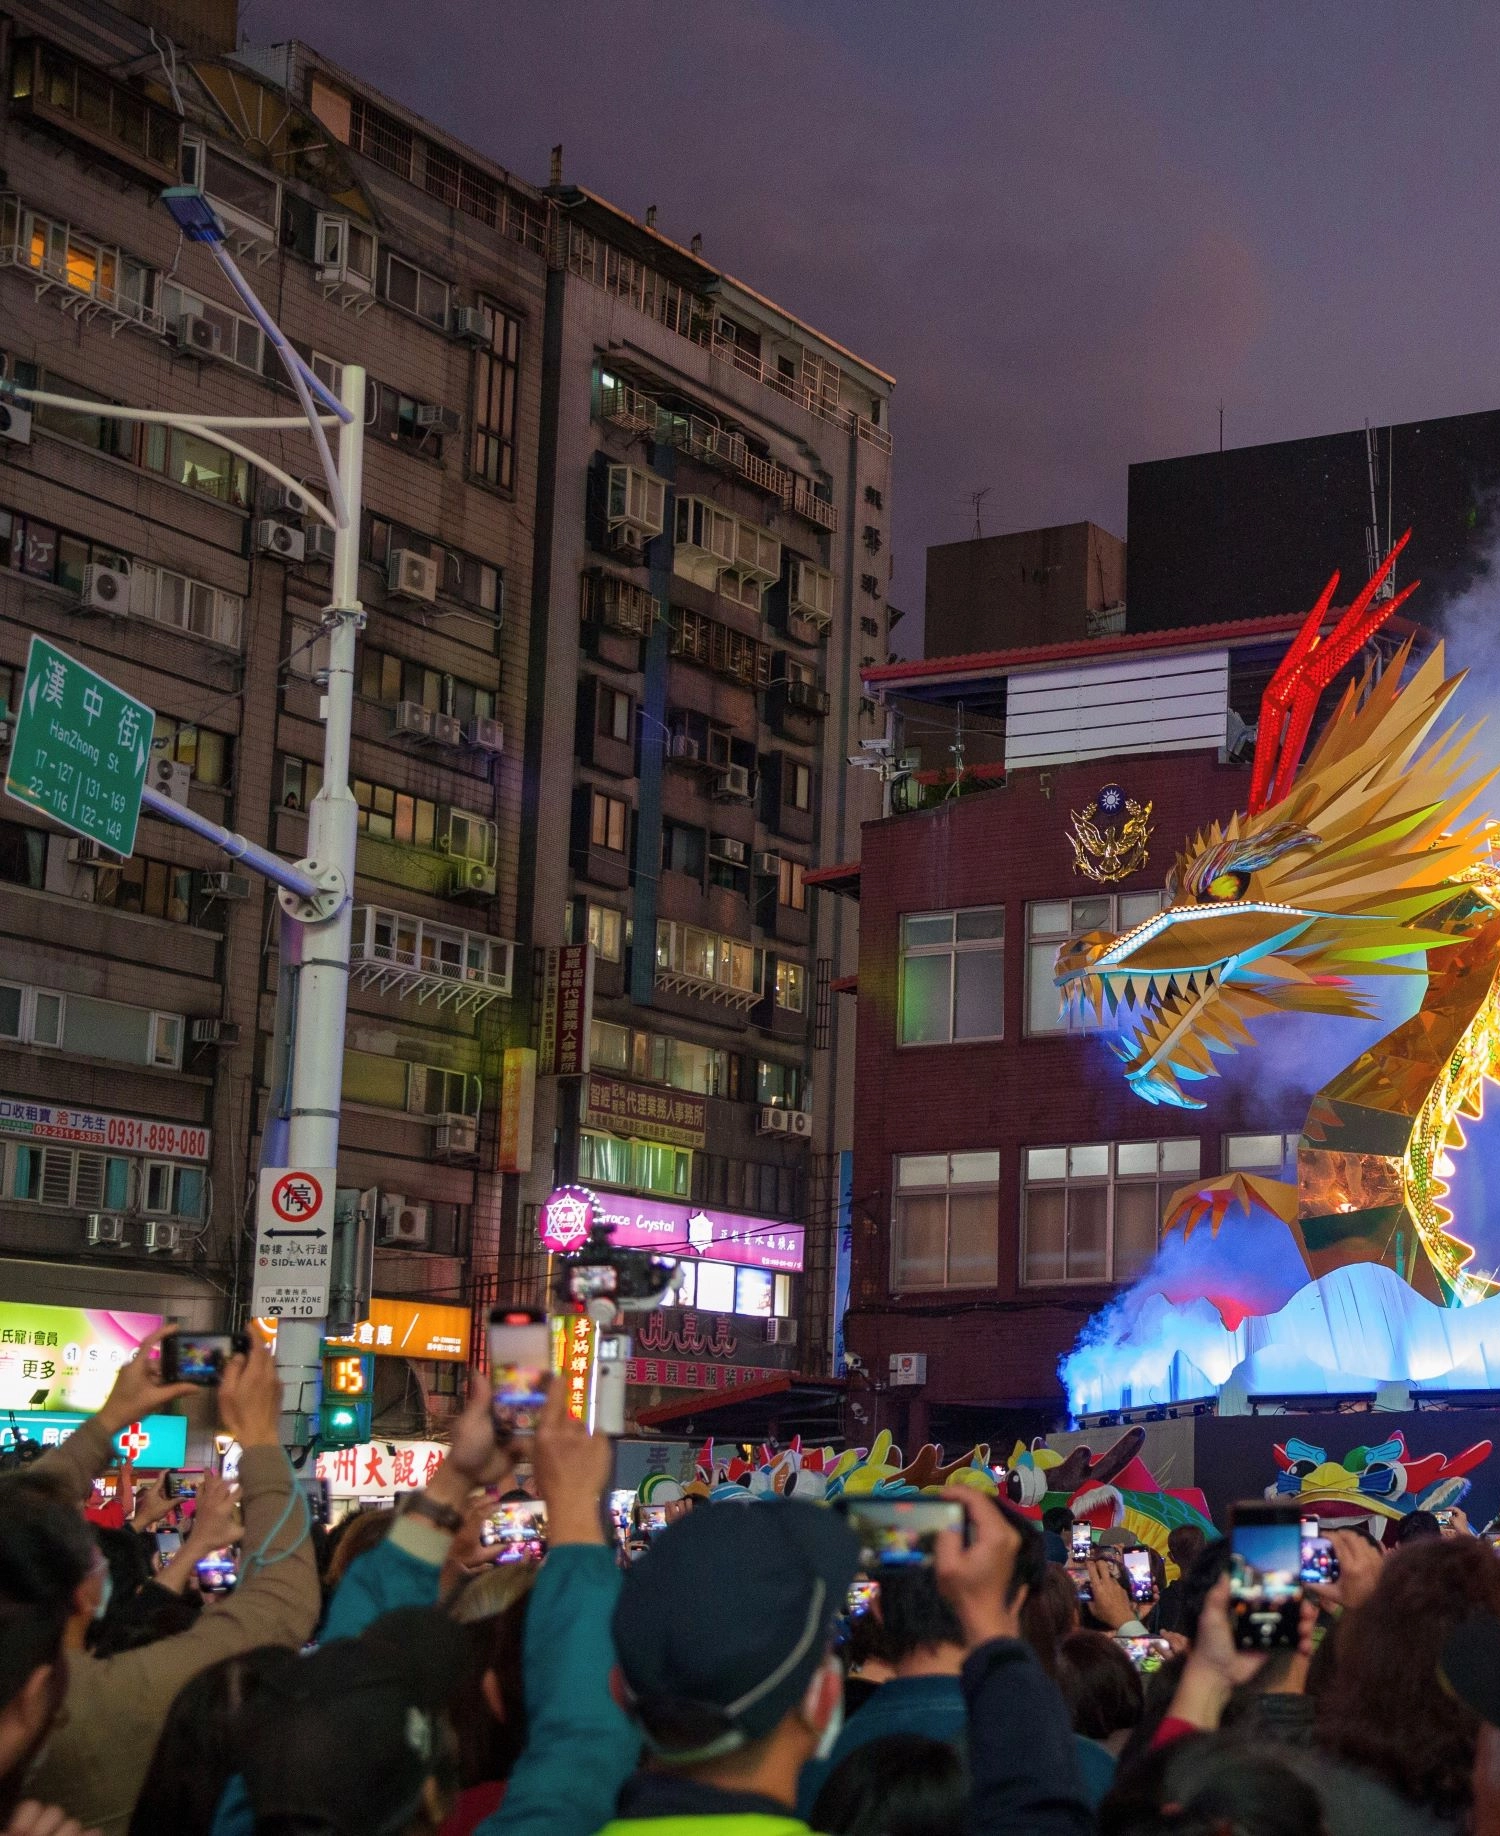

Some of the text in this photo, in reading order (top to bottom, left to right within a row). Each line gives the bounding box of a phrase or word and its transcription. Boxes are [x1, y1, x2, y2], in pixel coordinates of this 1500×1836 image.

[41, 656, 141, 752] 漢中街
[50, 719, 120, 774] HanZhong St
[108, 1118, 206, 1156] 0931-899-080
[636, 1214, 675, 1233] Crystal
[261, 1296, 322, 1304] TOW-AWAY ZONE
[291, 1306, 313, 1315] 110
[22, 1359, 56, 1380] 更多
[335, 1358, 363, 1391] 15
